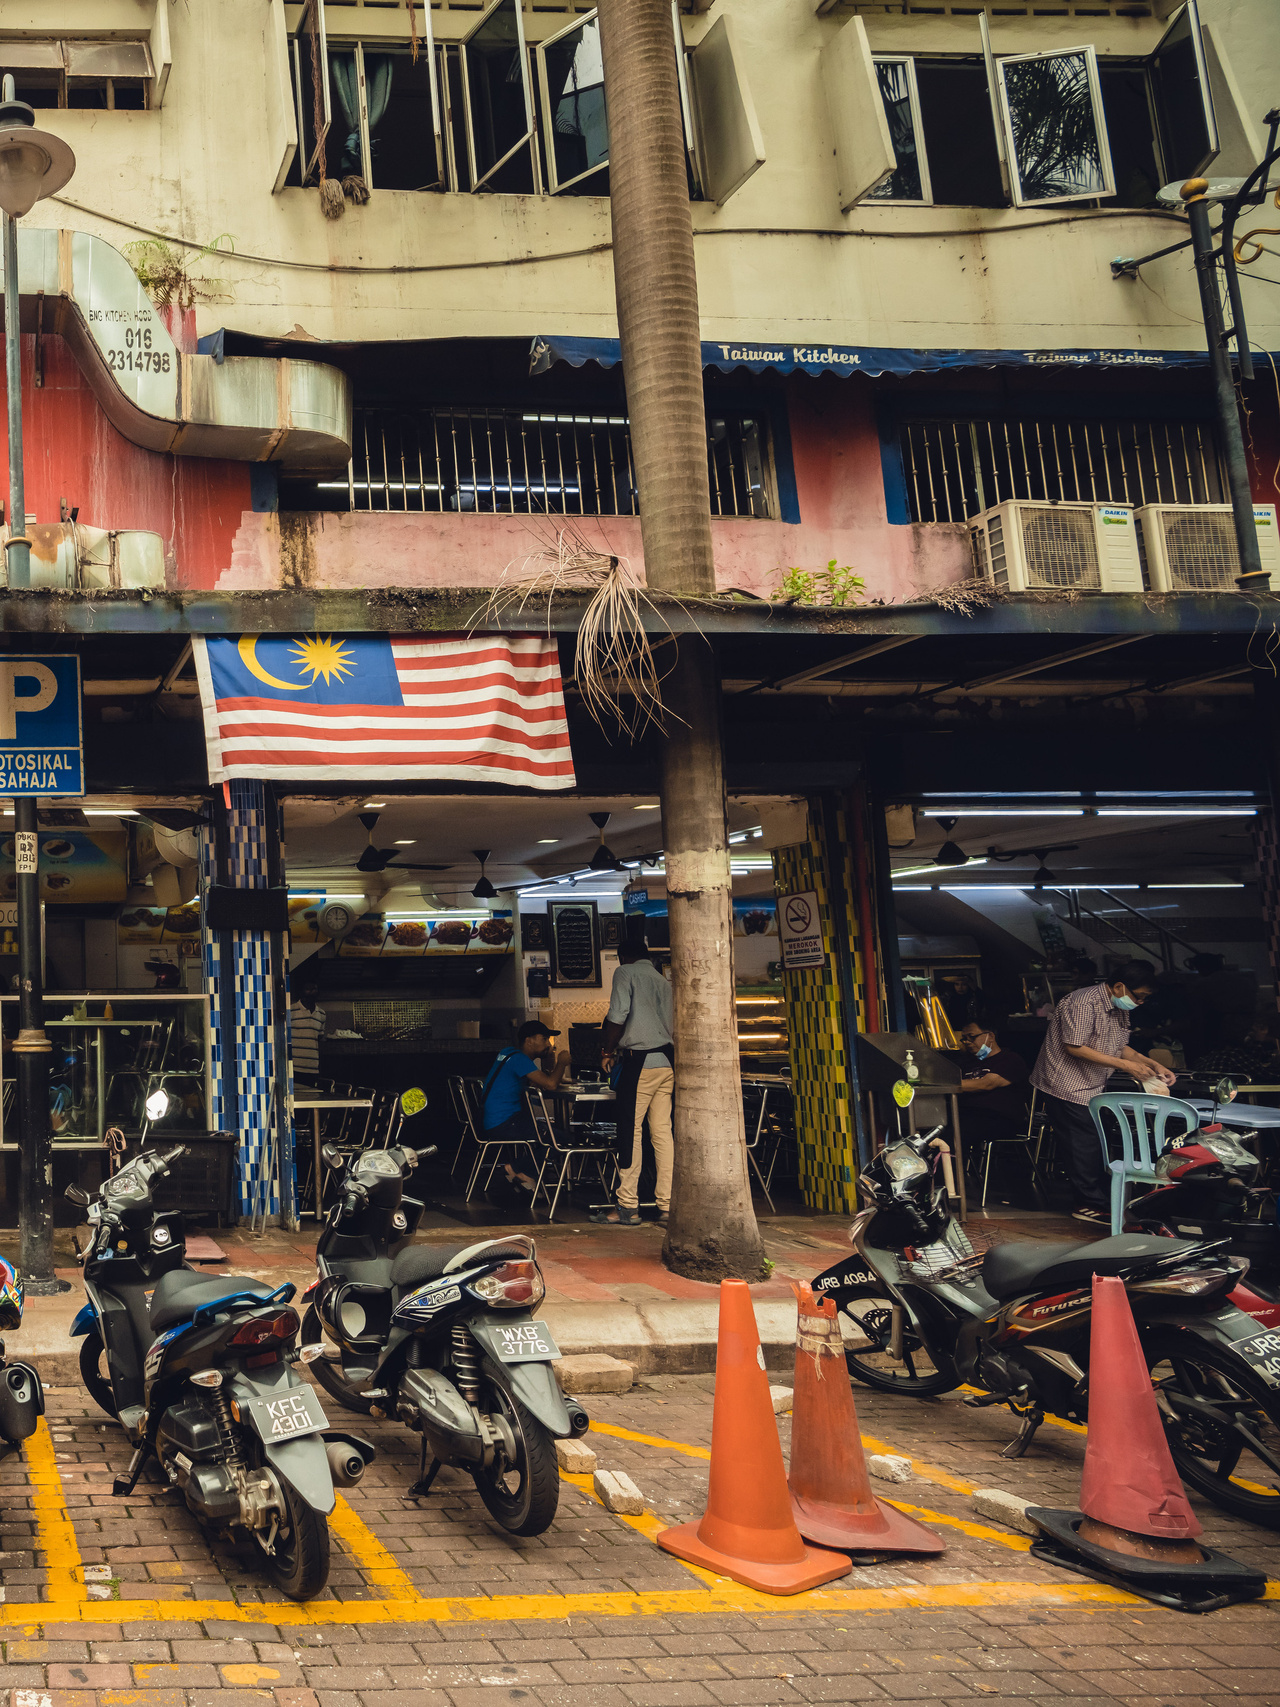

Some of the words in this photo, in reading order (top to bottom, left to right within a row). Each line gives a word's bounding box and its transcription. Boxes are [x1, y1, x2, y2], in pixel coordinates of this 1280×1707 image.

[125, 327, 152, 349] 016
[108, 349, 170, 374] 2314798
[718, 345, 786, 362] Taiwan
[793, 347, 861, 364] Kitchen
[629, 892, 647, 905] CASHIER
[788, 941, 818, 949] MEROKOK
[817, 1276, 840, 1290] JRB
[843, 1271, 877, 1287] 4084
[501, 1326, 538, 1341] WXB
[501, 1339, 550, 1355] 3776
[266, 1395, 306, 1419] KFC
[271, 1410, 313, 1434] 4301
